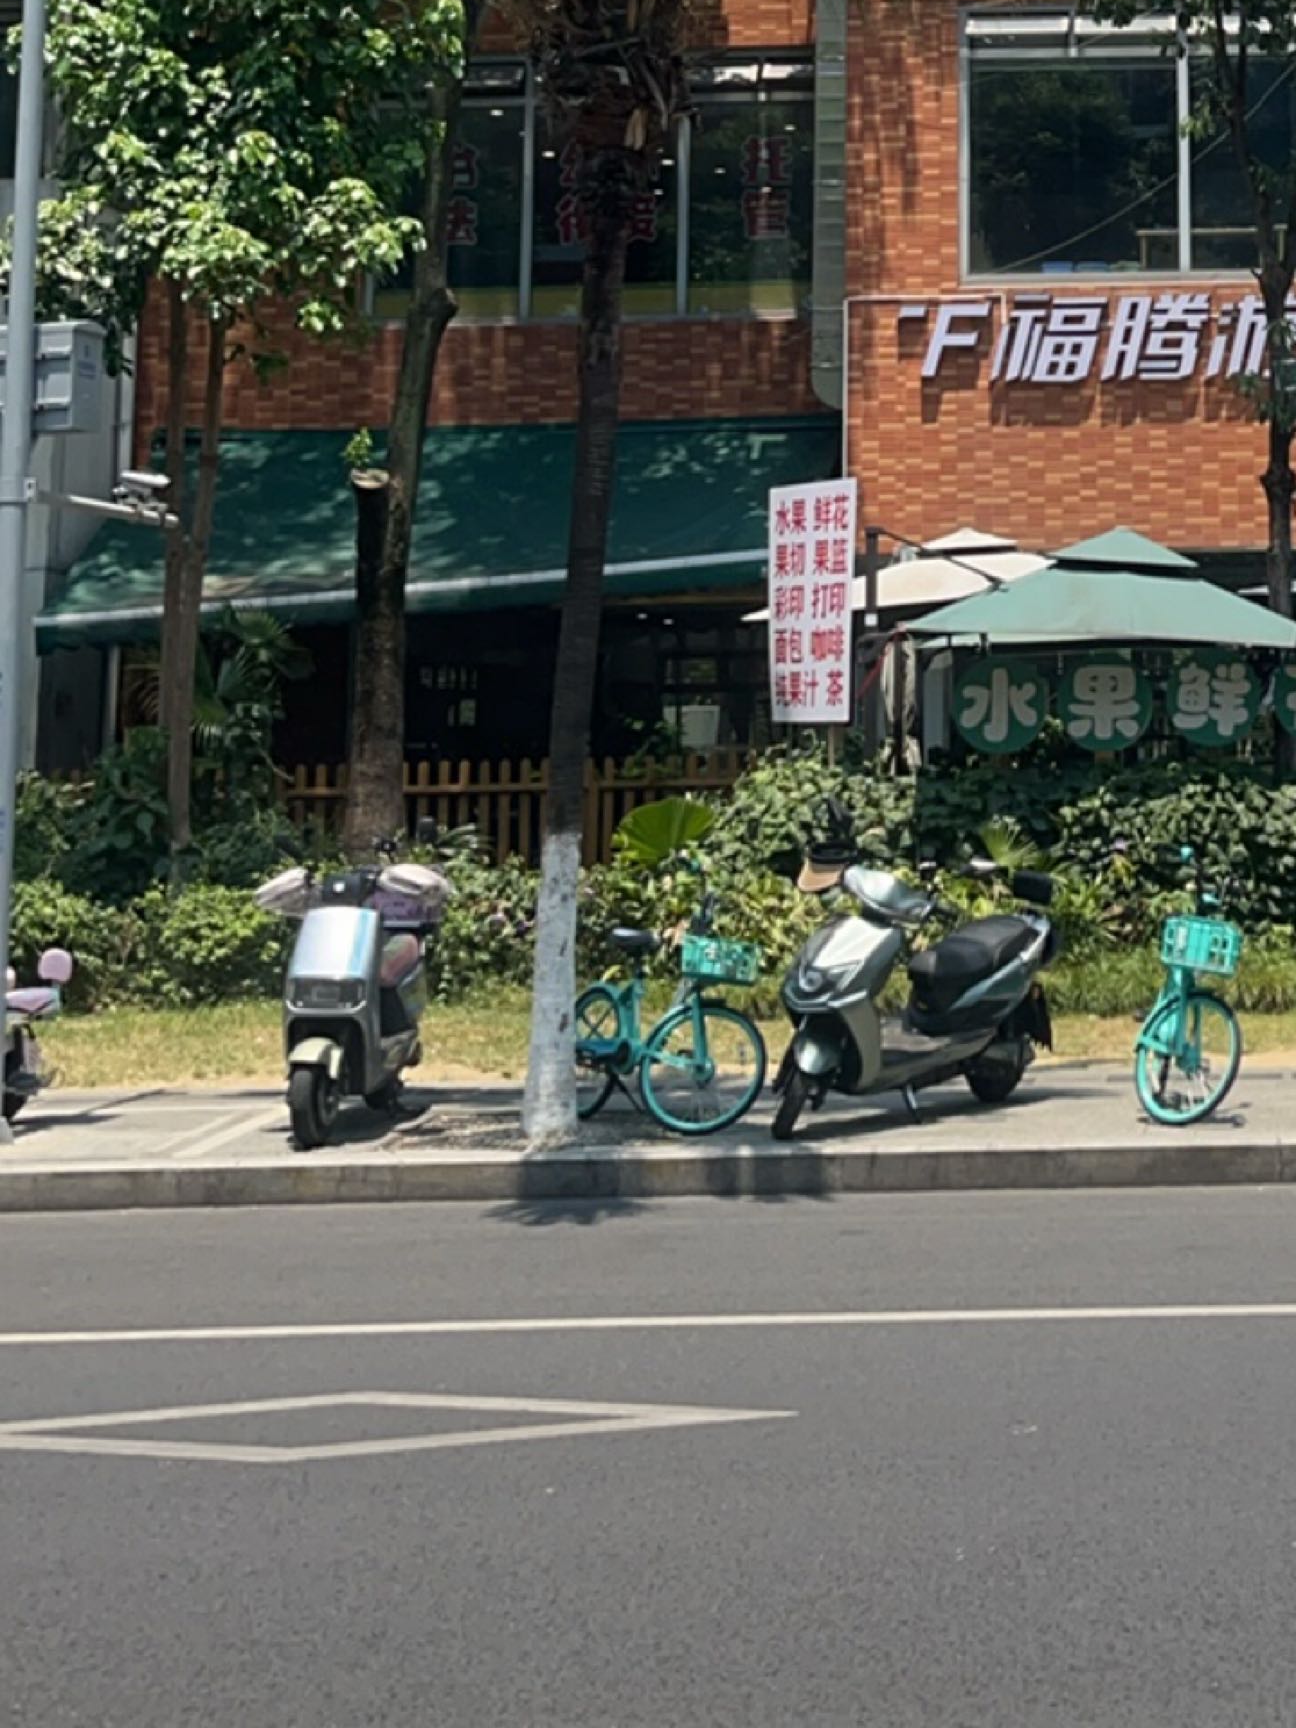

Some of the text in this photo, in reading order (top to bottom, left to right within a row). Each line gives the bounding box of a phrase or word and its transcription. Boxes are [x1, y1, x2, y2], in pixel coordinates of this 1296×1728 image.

[775, 492, 849, 535] 水果 鲜花
[812, 581, 846, 619] 打印
[825, 668, 843, 708] 茶
